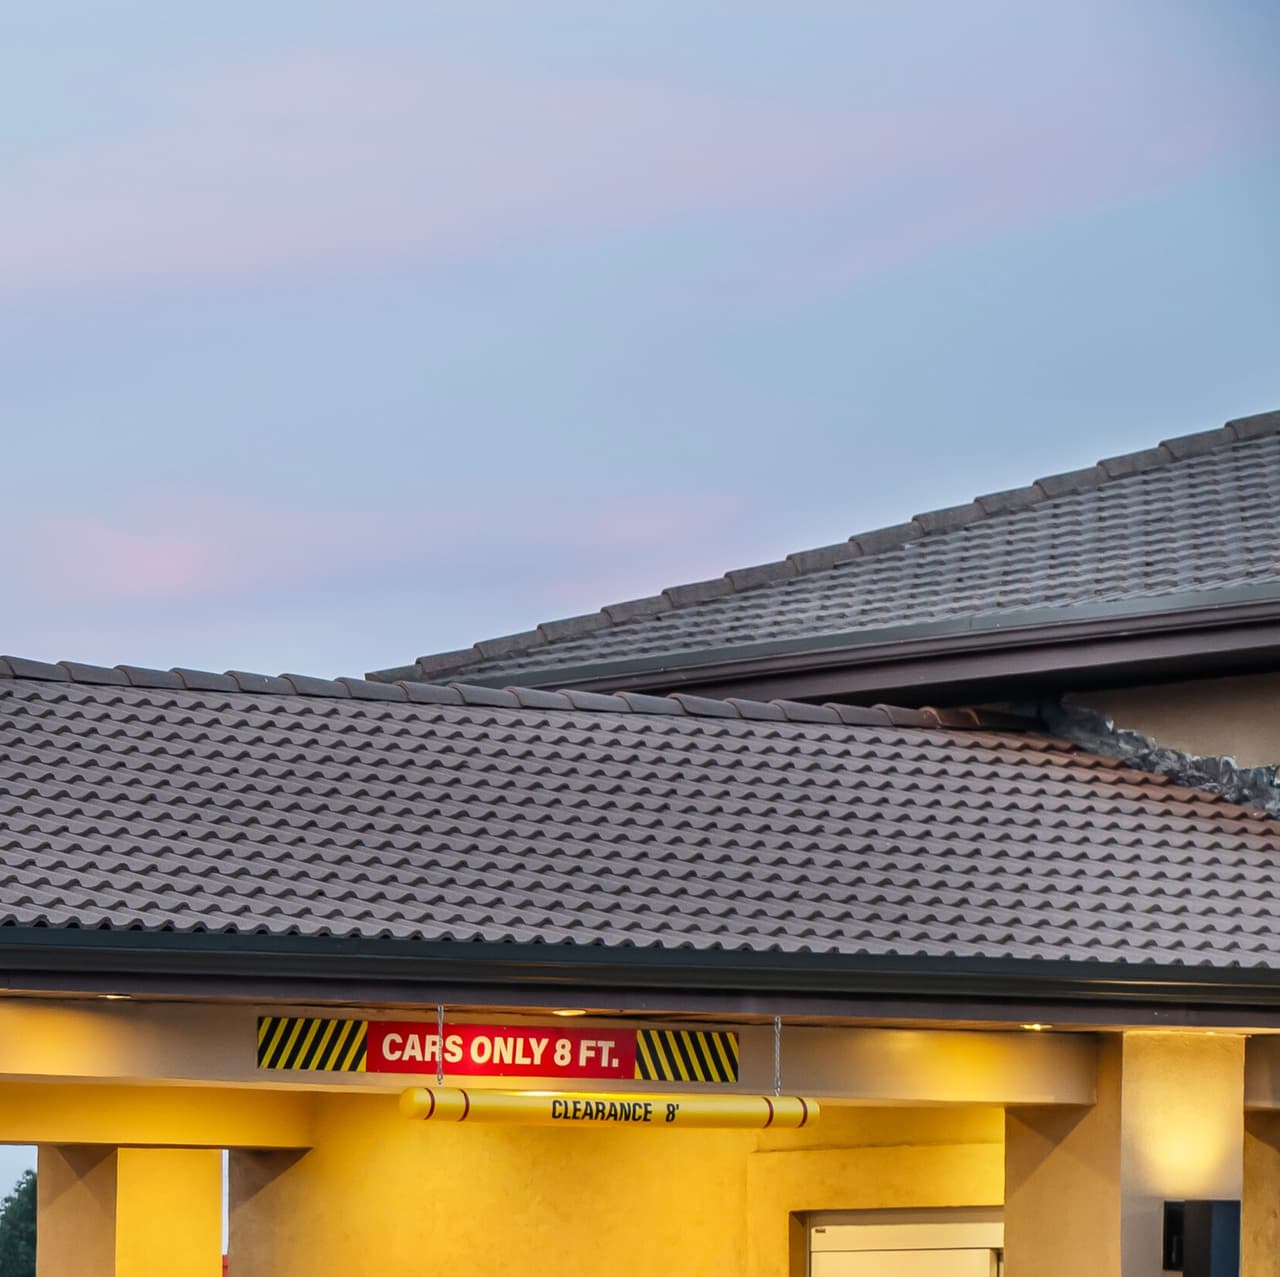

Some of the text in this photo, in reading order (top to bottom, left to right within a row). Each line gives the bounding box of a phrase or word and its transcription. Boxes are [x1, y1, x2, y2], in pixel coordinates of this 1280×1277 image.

[382, 1032, 619, 1067] CARS ONLY 8 FT.
[552, 1099, 679, 1122] CLEARANCE 8'
